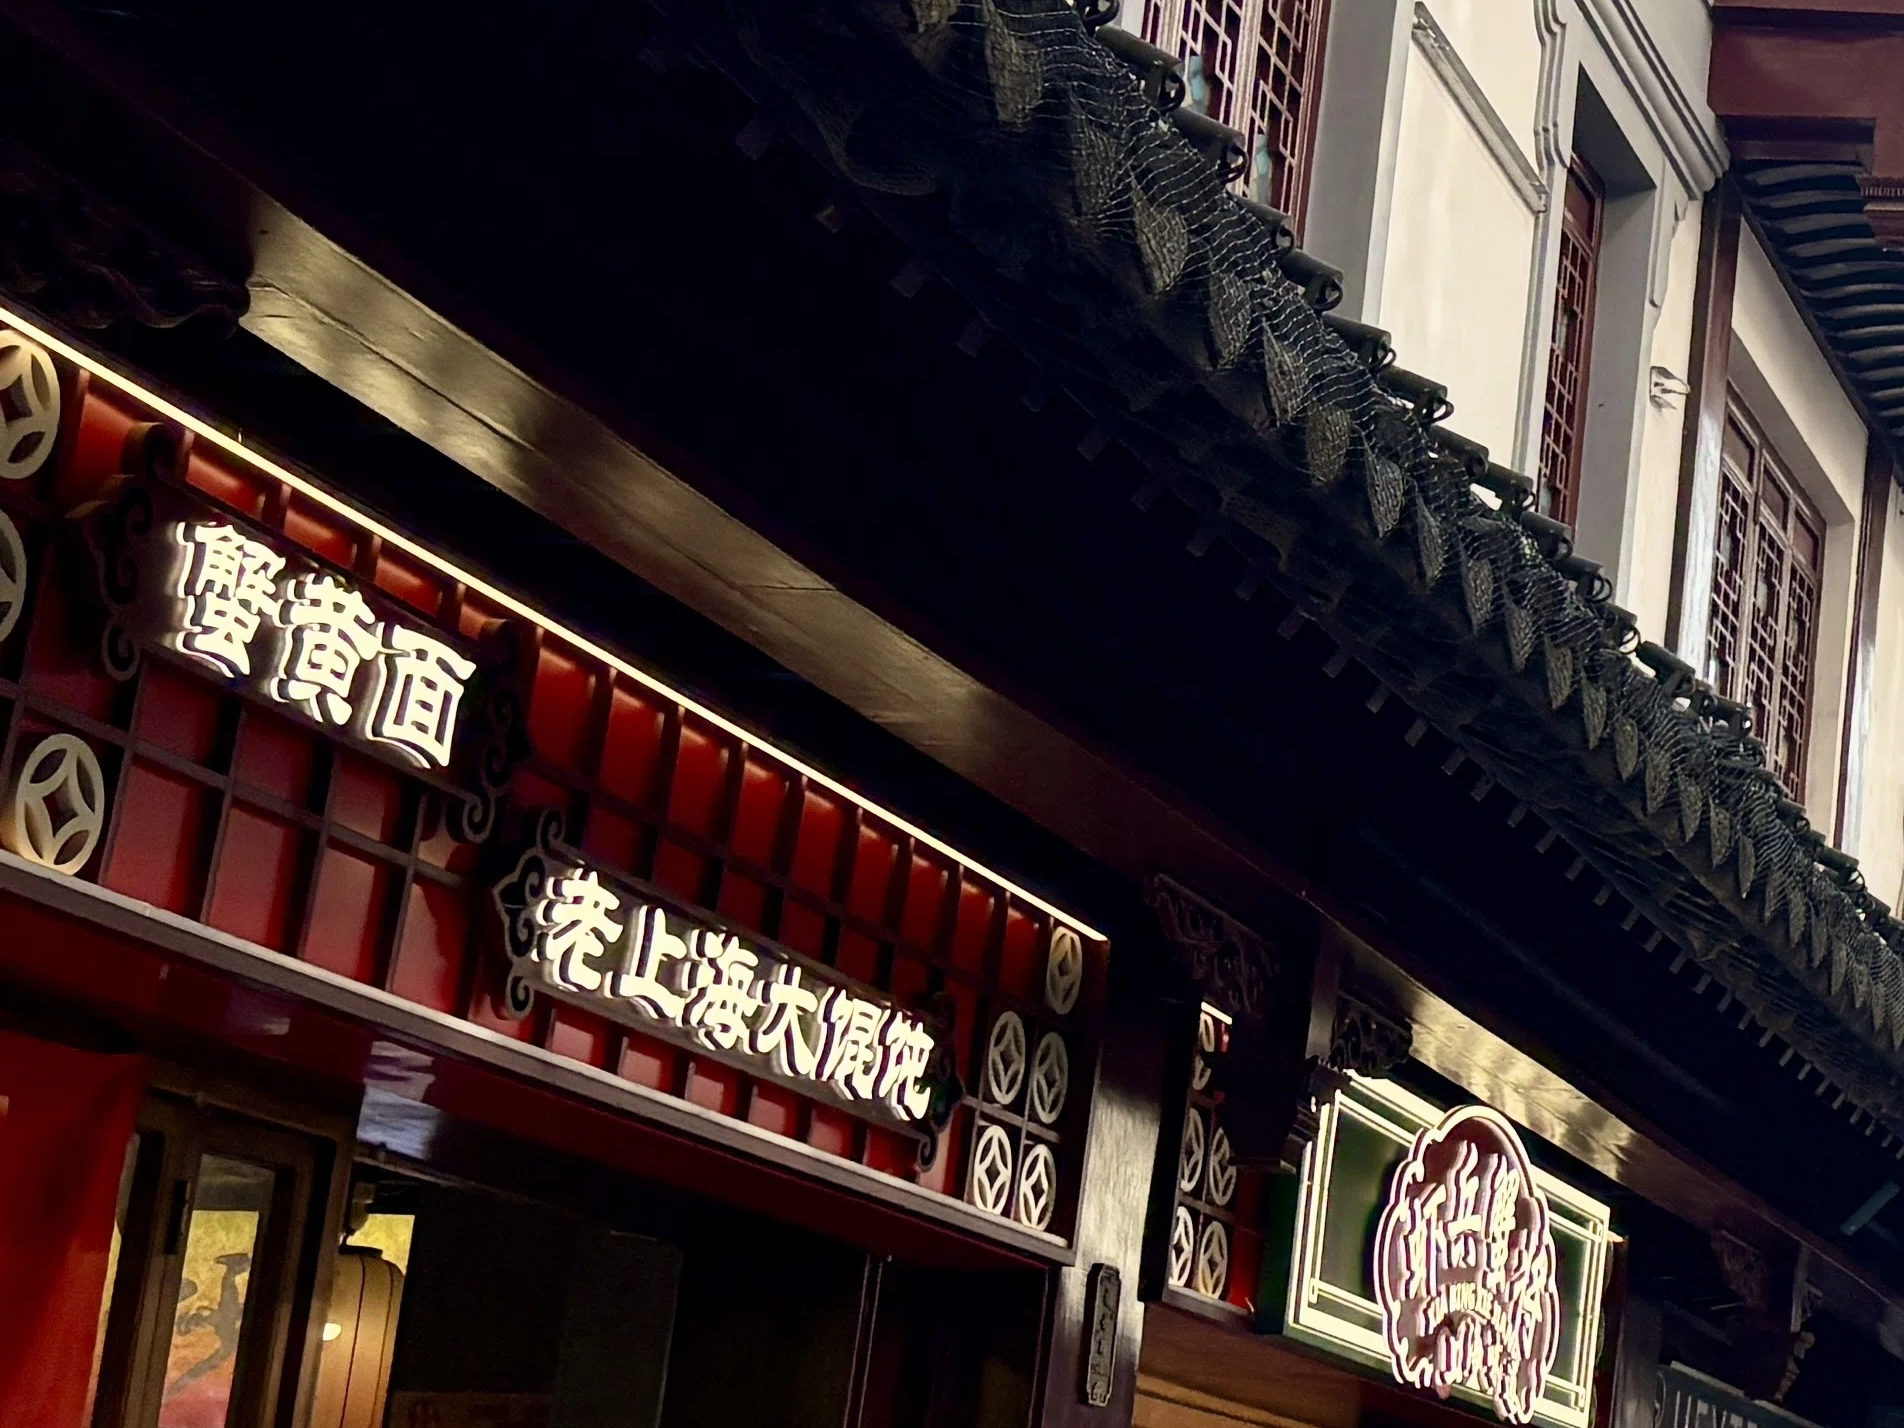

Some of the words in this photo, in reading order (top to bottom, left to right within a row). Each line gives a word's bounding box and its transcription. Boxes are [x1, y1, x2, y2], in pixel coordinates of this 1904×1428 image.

[178, 520, 477, 770] 蟹黄面
[535, 868, 936, 1121] 老上海大馄饨
